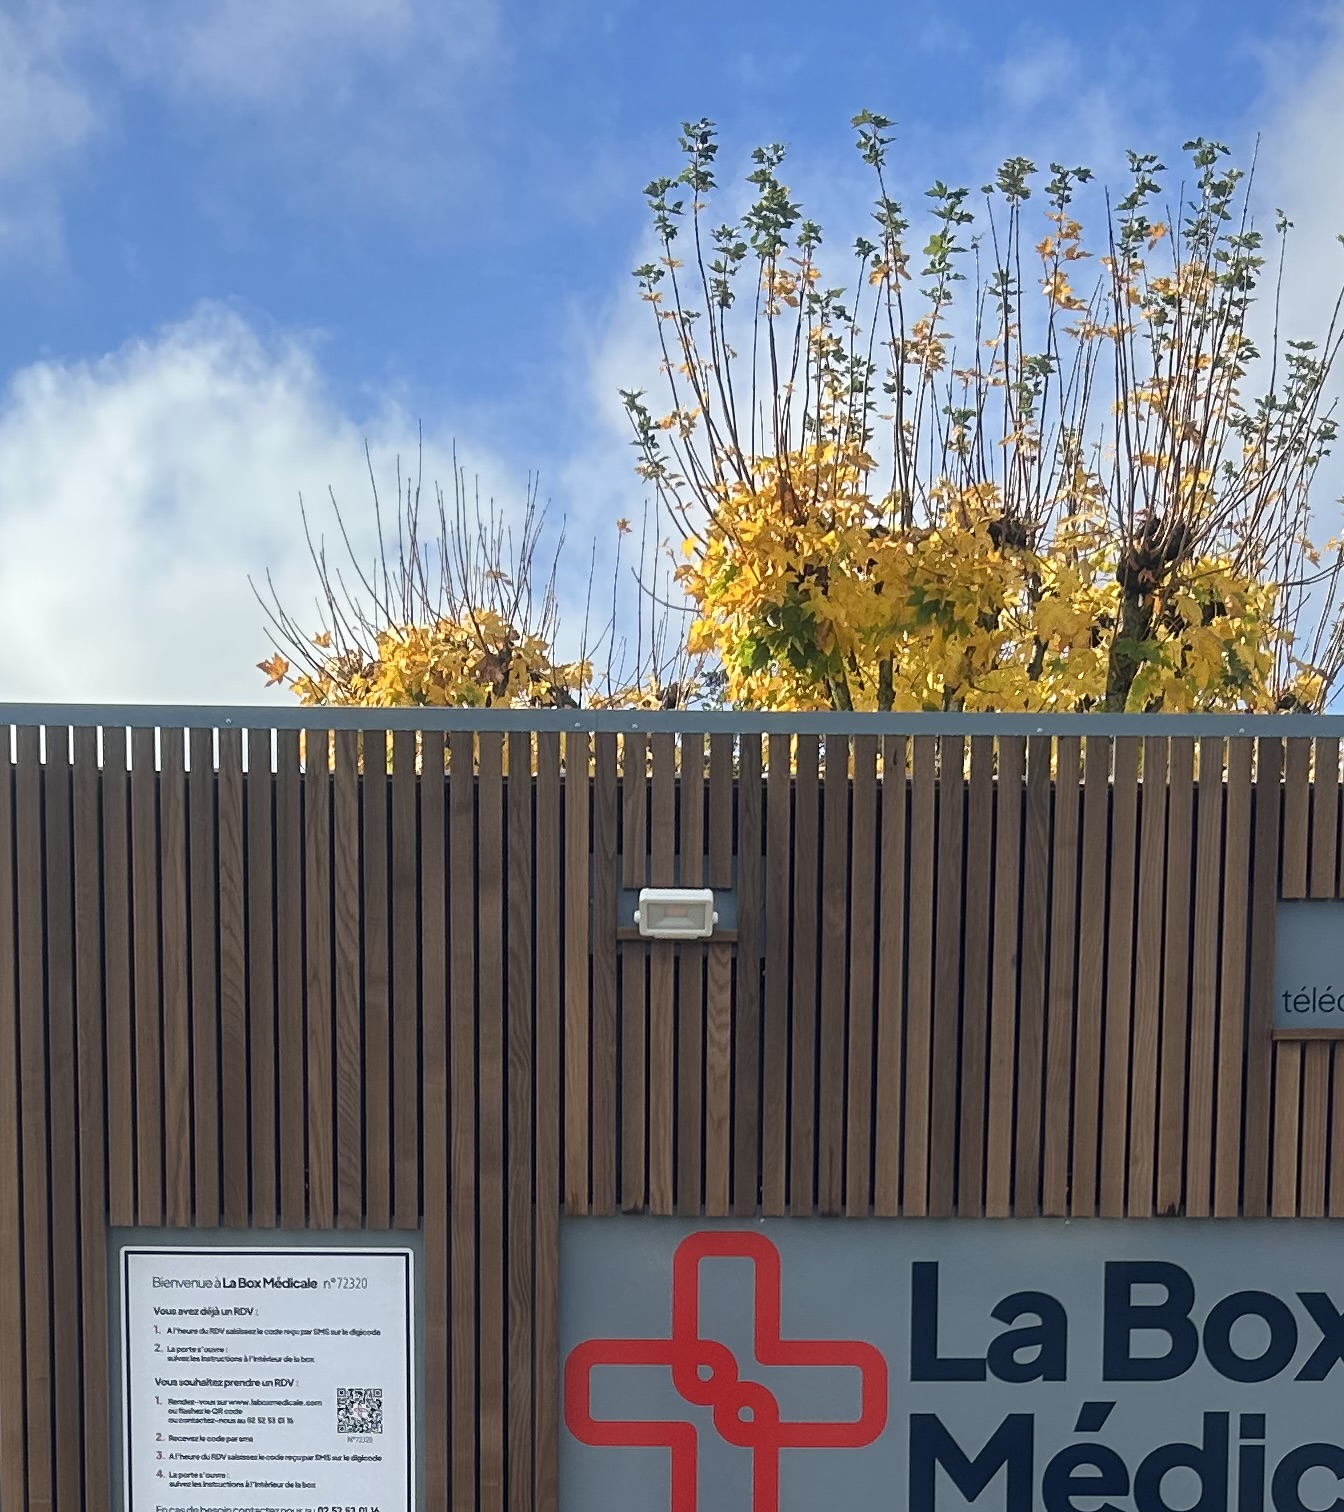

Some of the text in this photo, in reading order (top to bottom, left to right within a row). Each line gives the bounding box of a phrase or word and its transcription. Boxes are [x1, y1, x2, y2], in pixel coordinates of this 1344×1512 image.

[152, 1276, 213, 1289] Bienvenue
[214, 1276, 222, 1288] à
[222, 1277, 237, 1289] La
[238, 1277, 262, 1289] Box
[262, 1276, 318, 1289] Médicale
[153, 1306, 177, 1316] Vous
[178, 1308, 199, 1316] avez
[199, 1305, 220, 1318] déjà
[221, 1308, 233, 1316] un
[234, 1307, 254, 1316] RDV
[909, 1260, 1068, 1384] La
[155, 1377, 178, 1386] Vous
[178, 1377, 223, 1387] souhaitez
[224, 1378, 261, 1388] prendre
[274, 1378, 295, 1387] RDV
